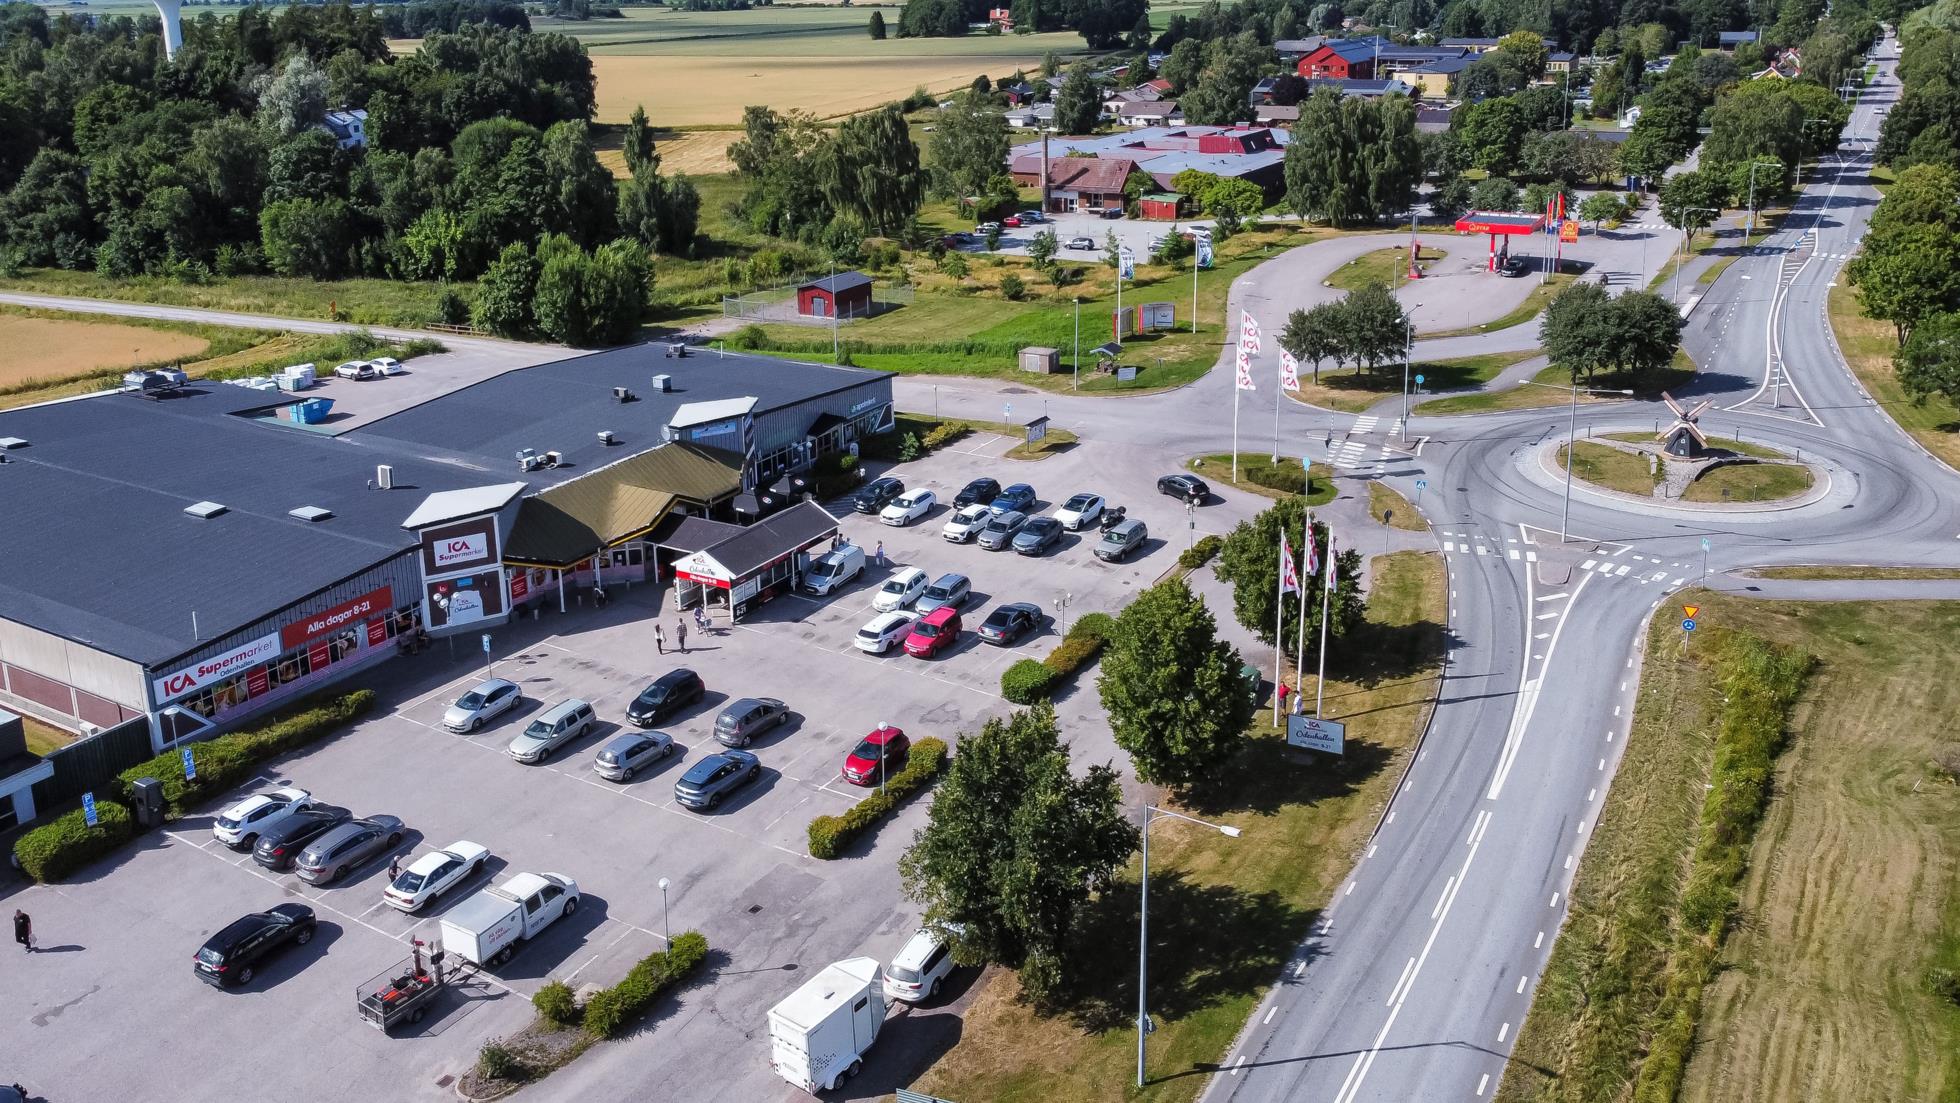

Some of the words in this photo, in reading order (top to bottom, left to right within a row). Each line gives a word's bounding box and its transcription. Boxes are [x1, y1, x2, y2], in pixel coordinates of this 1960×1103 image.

[1243, 339, 1259, 351] ICA
[447, 540, 471, 554] ICA
[307, 623, 326, 635] Alla
[326, 609, 353, 626] dagar
[353, 601, 371, 615] 8-21
[163, 672, 197, 697] ICA
[197, 640, 273, 678] Supermarket
[220, 659, 255, 677] Odenhallen
